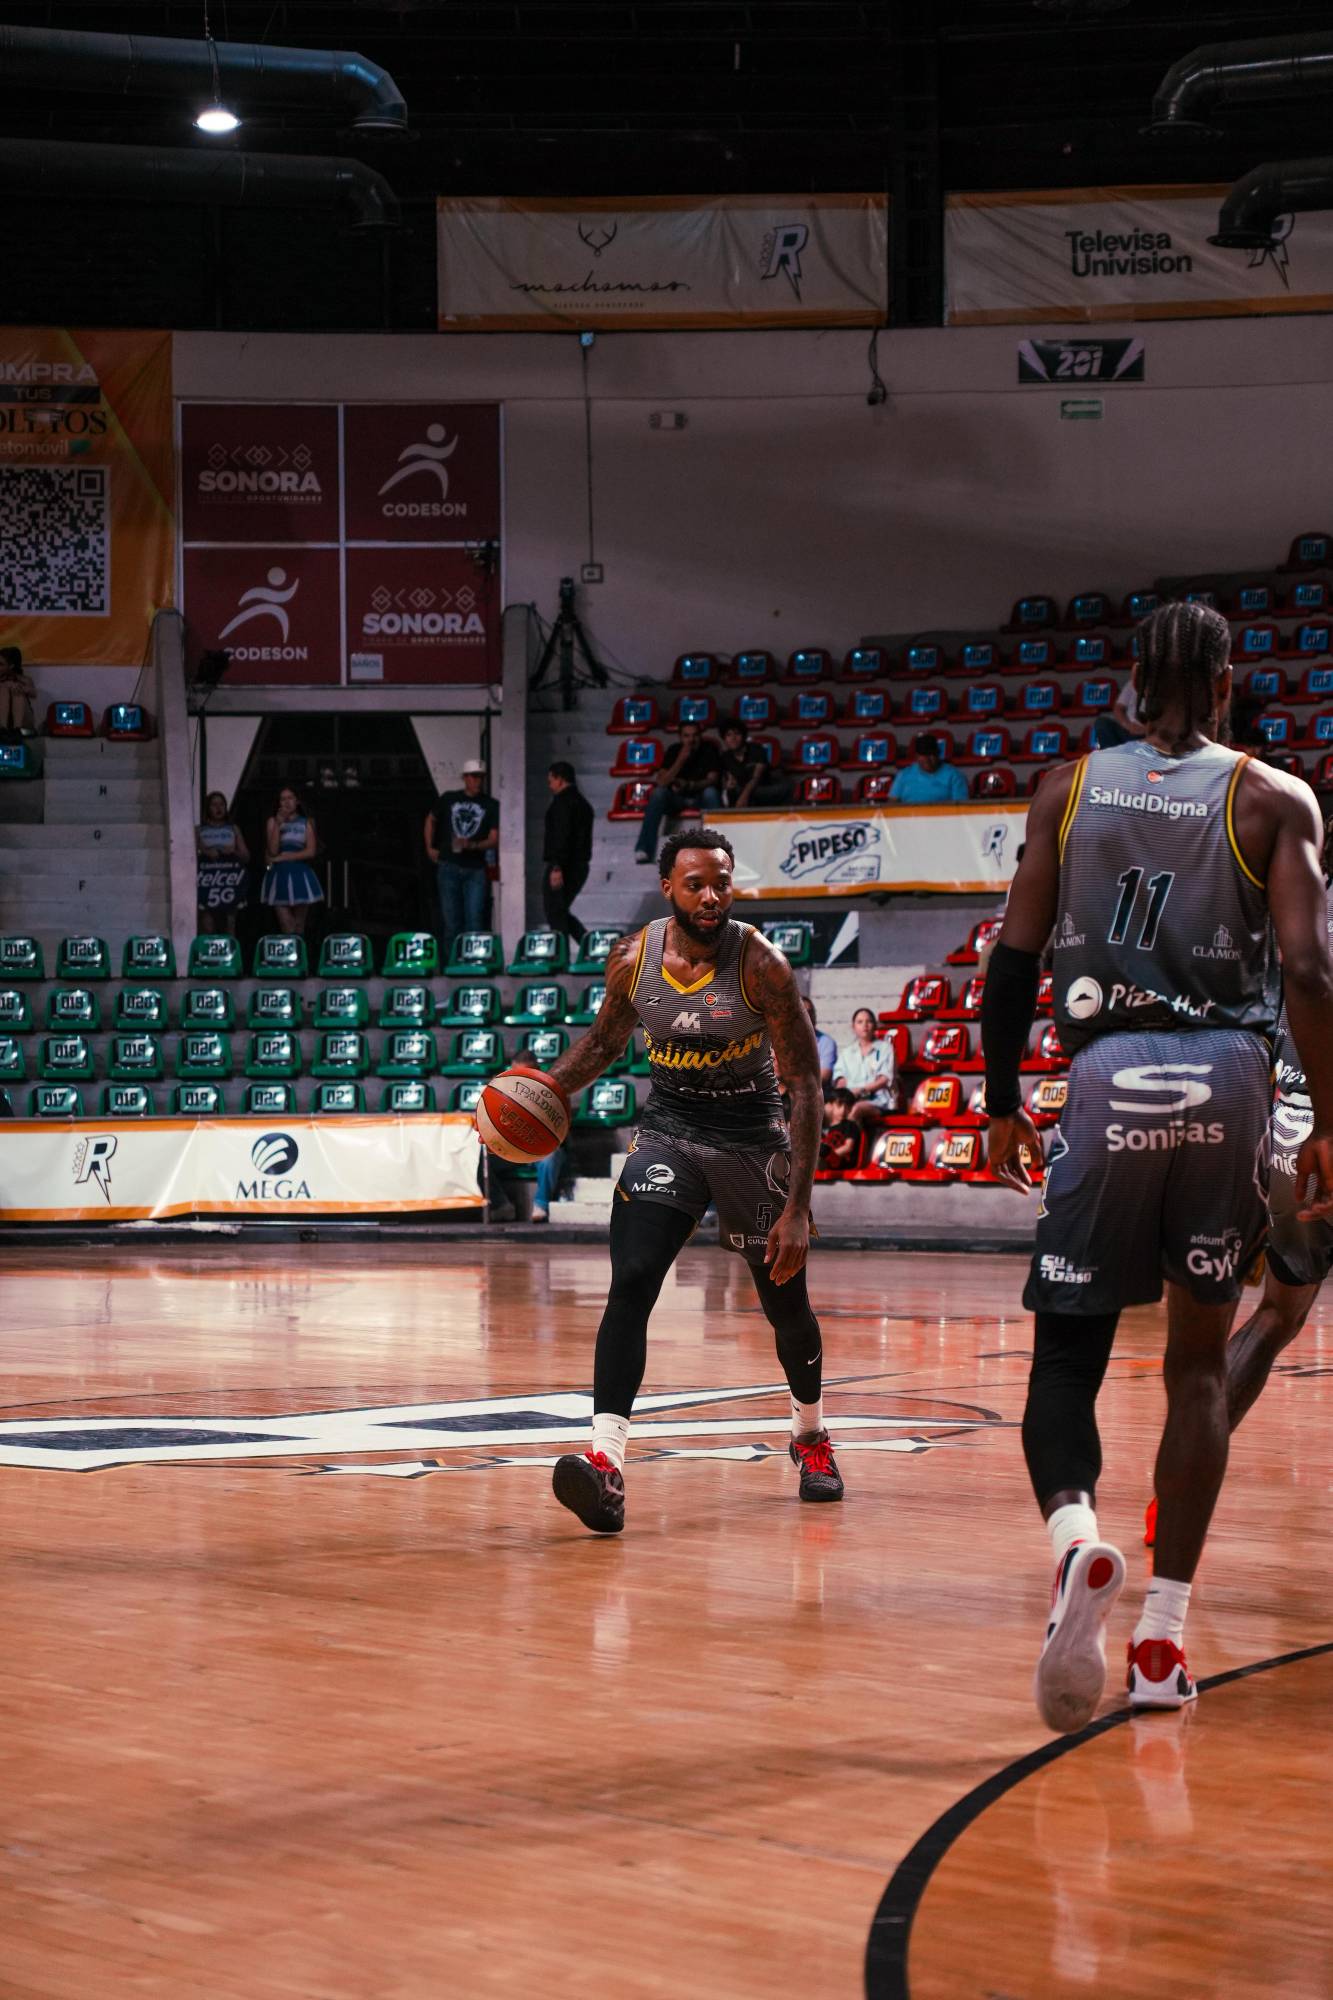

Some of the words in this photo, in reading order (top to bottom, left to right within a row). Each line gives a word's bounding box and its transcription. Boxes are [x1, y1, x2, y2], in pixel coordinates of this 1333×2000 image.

[1065, 229, 1172, 253] Televisa
[1072, 253, 1193, 277] Univision
[0, 362, 99, 382] MPRA
[1055, 350, 1103, 377] 201
[14, 386, 53, 400] TUS
[198, 470, 322, 493] SONORA
[382, 503, 468, 517] CODESON
[362, 612, 486, 635] SONORA
[1089, 786, 1209, 820] SaludDigna
[798, 827, 867, 864] PIPESO
[197, 869, 246, 886] telcel
[207, 887, 236, 908] 5G
[1108, 866, 1175, 951] 11
[395, 939, 434, 961] 025
[1054, 935, 1086, 950] LAMONT
[1192, 945, 1242, 961] CLAMON
[1171, 994, 1217, 1019] Hut
[55, 1043, 78, 1058] 018
[43, 1092, 67, 1107] 017
[114, 1092, 139, 1107] 018
[927, 1087, 950, 1103] 003
[1042, 1086, 1067, 1103] 005
[945, 1141, 970, 1157] 004
[236, 1179, 312, 1200] MEGA
[756, 1202, 773, 1232] 5
